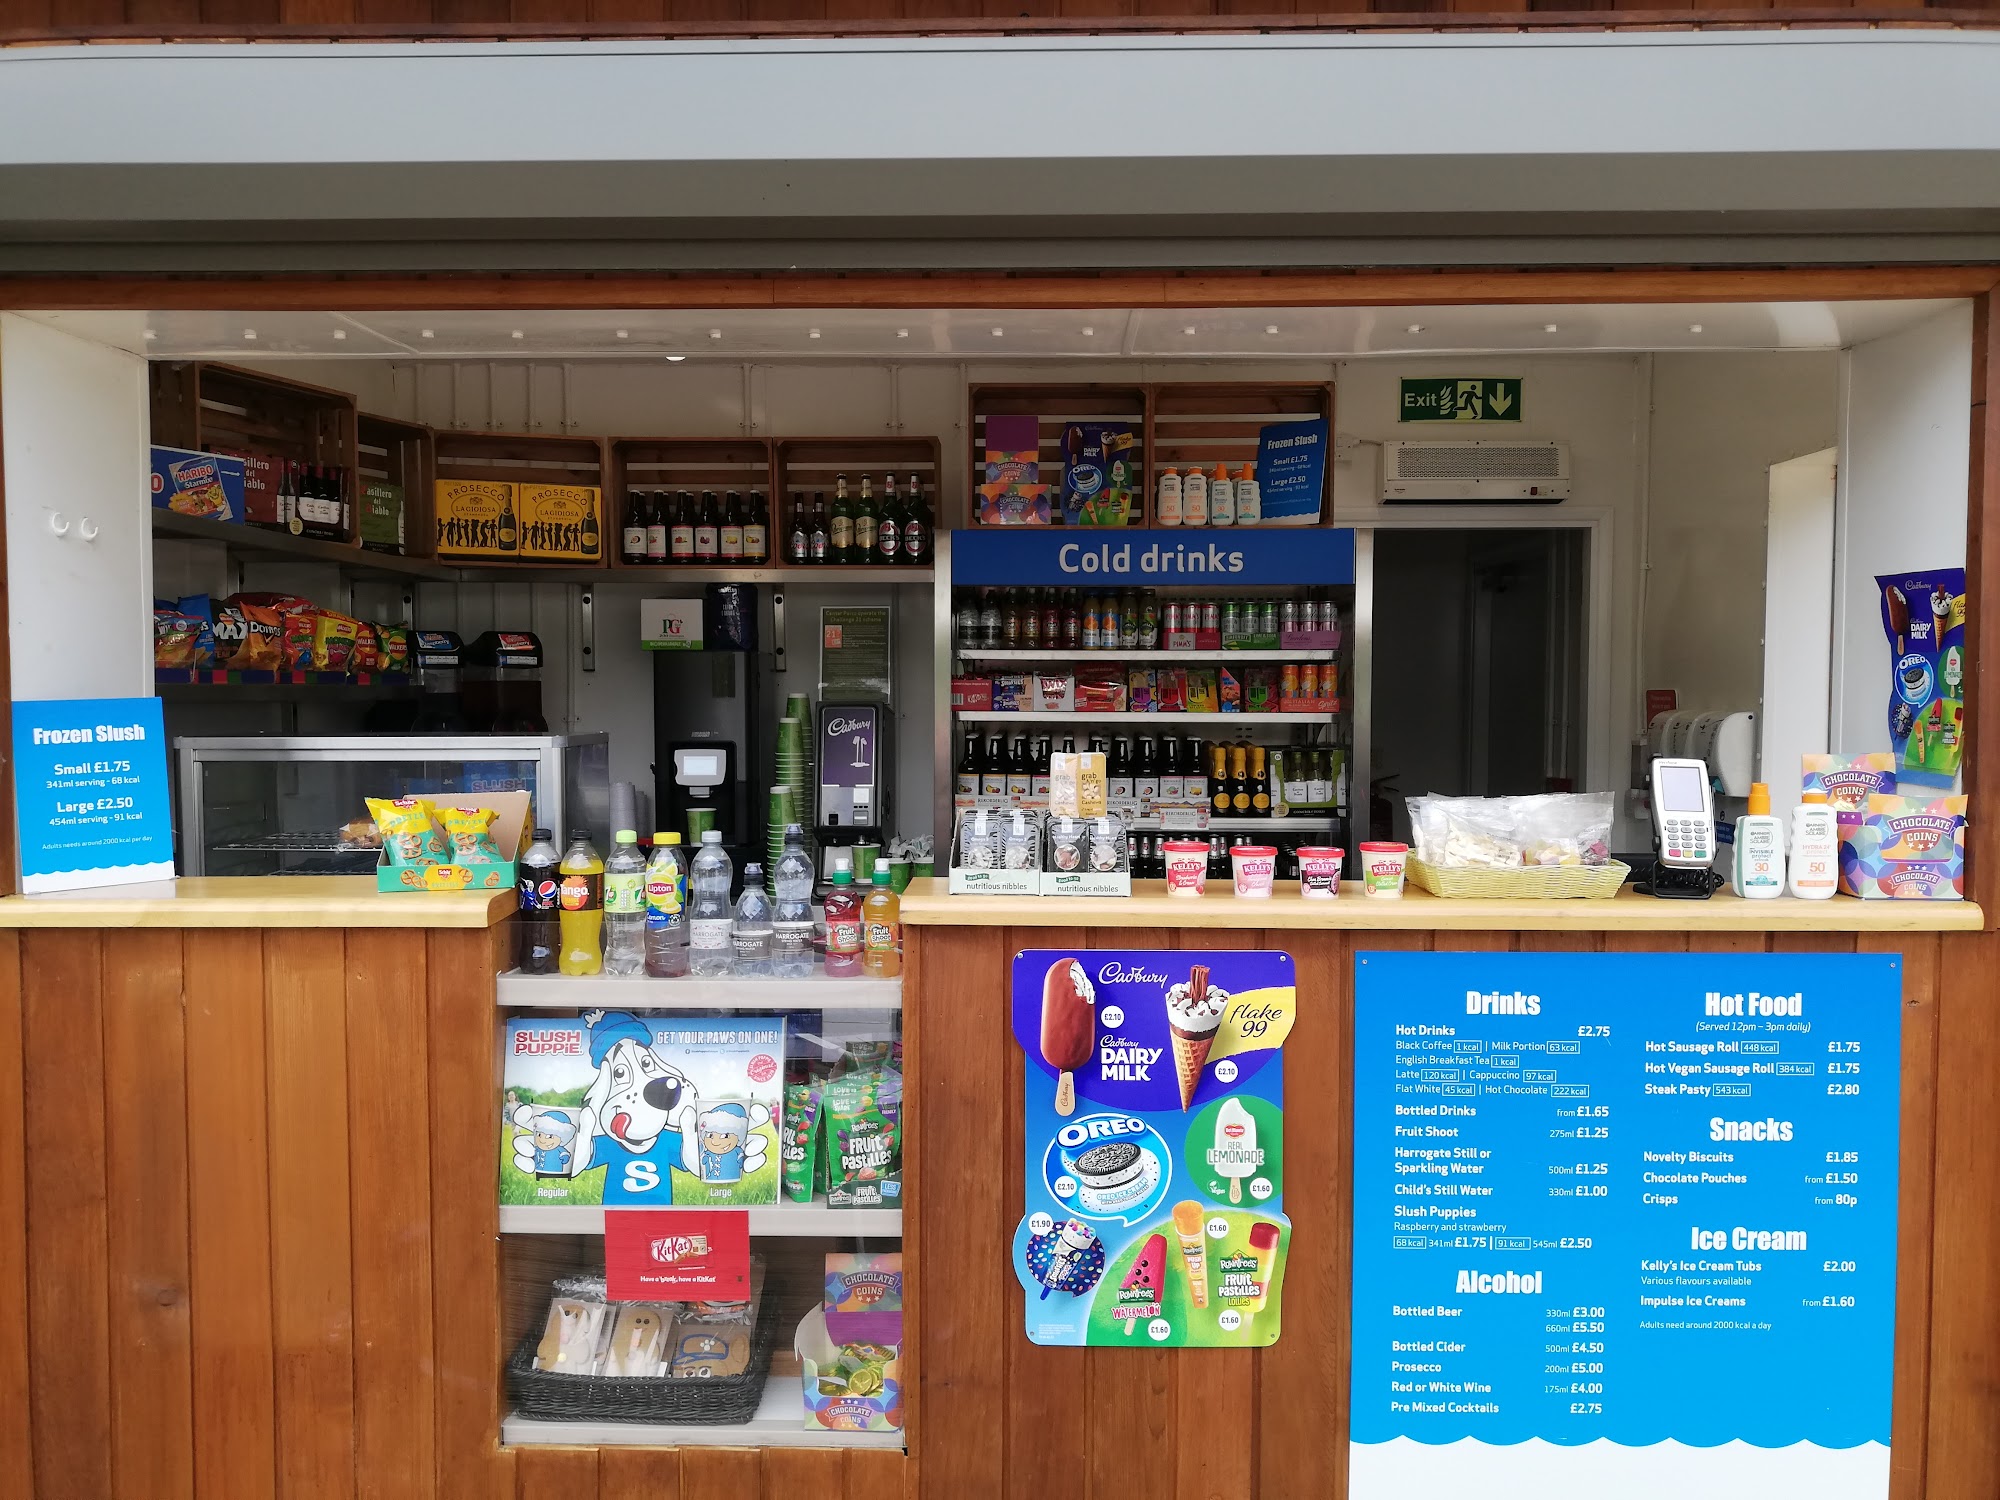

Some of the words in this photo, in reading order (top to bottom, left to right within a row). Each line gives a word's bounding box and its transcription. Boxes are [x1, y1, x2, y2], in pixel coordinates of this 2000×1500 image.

[1405, 393, 1437, 406] Exit
[1268, 437, 1292, 450] Frozen
[1294, 434, 1318, 447] Slush
[1273, 456, 1289, 466] Small
[1291, 454, 1308, 464] £1.75
[178, 465, 213, 482] HARIBO
[1072, 465, 1096, 473] OREO
[184, 476, 213, 489] Starmix
[1271, 478, 1288, 487] Large
[1289, 476, 1306, 485] £2.50
[447, 485, 504, 501] PROSECCO
[1059, 544, 1131, 573] Cold
[1141, 544, 1244, 572] drinks
[1905, 580, 1932, 591] Cadbury
[662, 619, 680, 634] PG
[1911, 623, 1931, 632] DAIRY
[1911, 631, 1927, 639] MILK
[1899, 656, 1926, 669] OREO
[828, 718, 871, 736] Cadbury
[33, 728, 93, 745] Frozen
[96, 724, 145, 742] Slush
[54, 763, 91, 775] Small
[94, 761, 131, 773] £1.75
[46, 779, 73, 789] 341ml
[75, 778, 105, 788] serving
[111, 777, 123, 785] 68
[124, 776, 140, 785] kcal
[1081, 773, 1097, 781] grab
[1824, 772, 1878, 786] CHOCOLATE
[1836, 786, 1864, 796] COINS
[57, 802, 94, 814] Large
[97, 797, 133, 810] £2.50
[49, 817, 76, 826] 454ml
[78, 816, 108, 825] serving
[114, 813, 124, 821] 91
[126, 812, 142, 820] kcal
[1893, 817, 1952, 832] CHOCOLATE
[103, 837, 118, 845] 2000
[1906, 831, 1939, 843] COINS
[1173, 862, 1201, 872] KELLY'S
[1243, 863, 1271, 872] KELLY'S
[1306, 862, 1335, 872] KELLY'S
[1373, 864, 1401, 873] KELLY'S
[1754, 862, 1769, 872] 30
[1809, 862, 1826, 873] 50
[648, 883, 672, 894] Lipton
[1002, 882, 1027, 890] nibbles
[1094, 885, 1118, 893] nibbles
[1098, 961, 1168, 988] Cadbury
[1466, 991, 1540, 1015] Drinks
[1705, 992, 1744, 1016] Hot
[1748, 993, 1802, 1016] Food
[1104, 1012, 1122, 1021] £2.10
[1229, 1004, 1283, 1024] flake
[1240, 1021, 1267, 1038] 99
[1396, 1025, 1416, 1035] Hot
[1419, 1025, 1455, 1035] Drinks
[1578, 1026, 1610, 1037] £2.75
[1696, 1022, 1729, 1032] (Served
[1732, 1022, 1756, 1033] 12pm
[1765, 1022, 1784, 1033] 3pm
[1786, 1022, 1810, 1033] daily)
[515, 1031, 581, 1043] SLUSH
[657, 1032, 676, 1044] GET
[678, 1032, 704, 1044] YOUR
[706, 1032, 736, 1044] PAWS
[738, 1031, 752, 1044] ON
[754, 1031, 778, 1044] ONE!
[1100, 1034, 1139, 1049] Cadbury
[1396, 1041, 1420, 1049] Black
[1422, 1041, 1452, 1049] Coffee
[1492, 1042, 1510, 1050] Milk
[1513, 1042, 1545, 1050] Portion
[1101, 1048, 1163, 1065] DAIRY
[1101, 1064, 1152, 1082] MILK
[1645, 1084, 1677, 1094] Steak
[1680, 1084, 1711, 1097] Pasty
[1716, 1086, 1731, 1094] 543
[1827, 1084, 1859, 1095] £2.80
[1396, 1105, 1437, 1115] Bottled
[1440, 1105, 1476, 1116] Drinks
[1577, 1106, 1609, 1117] £1.65
[1056, 1116, 1146, 1146] OREO
[1395, 1126, 1423, 1136] Fruit
[1425, 1126, 1458, 1137] Shoot
[1577, 1127, 1608, 1138] £1.25
[1710, 1117, 1793, 1141] Snacks
[1227, 1141, 1244, 1150] REAL
[1208, 1150, 1264, 1164] LEMONADE
[1644, 1151, 1686, 1164] Novelty
[1689, 1151, 1734, 1162] Biscuits
[1826, 1152, 1858, 1162] £1.85
[537, 1187, 569, 1199] Regular
[710, 1186, 732, 1198] Large
[1252, 1184, 1270, 1192] £1.60
[1395, 1184, 1431, 1195] Child's
[1434, 1184, 1457, 1195] Still
[1460, 1185, 1493, 1195] Water
[1549, 1188, 1573, 1196] 330ml
[1576, 1186, 1607, 1196] £1.00
[1643, 1193, 1678, 1206] Crisps
[1836, 1194, 1857, 1207] 80p
[1031, 1220, 1051, 1228] £1.90
[1691, 1227, 1727, 1250] Ice
[1732, 1227, 1807, 1250] Cream
[657, 1237, 688, 1261] KitKat
[1642, 1260, 1677, 1273] Kelly's
[1680, 1261, 1696, 1271] Ice
[1699, 1260, 1734, 1271] Cream
[1736, 1261, 1761, 1271] Tubs
[1824, 1261, 1856, 1272] £2.00
[843, 1274, 896, 1288] CHOCOLATE
[1456, 1270, 1542, 1294] Alcohol
[1676, 1276, 1710, 1285] flavours
[1713, 1277, 1751, 1285] available
[856, 1286, 884, 1296] COINS
[1393, 1306, 1434, 1316] Bottled
[1437, 1306, 1462, 1316] Beer
[1573, 1307, 1604, 1317] £3.00
[1150, 1326, 1168, 1334] £1.60
[1392, 1341, 1434, 1351] Bottled
[1436, 1341, 1465, 1352] Cider
[1572, 1342, 1604, 1353] £4.50
[1392, 1361, 1441, 1372] Prosecco
[1572, 1363, 1603, 1373] £5.00
